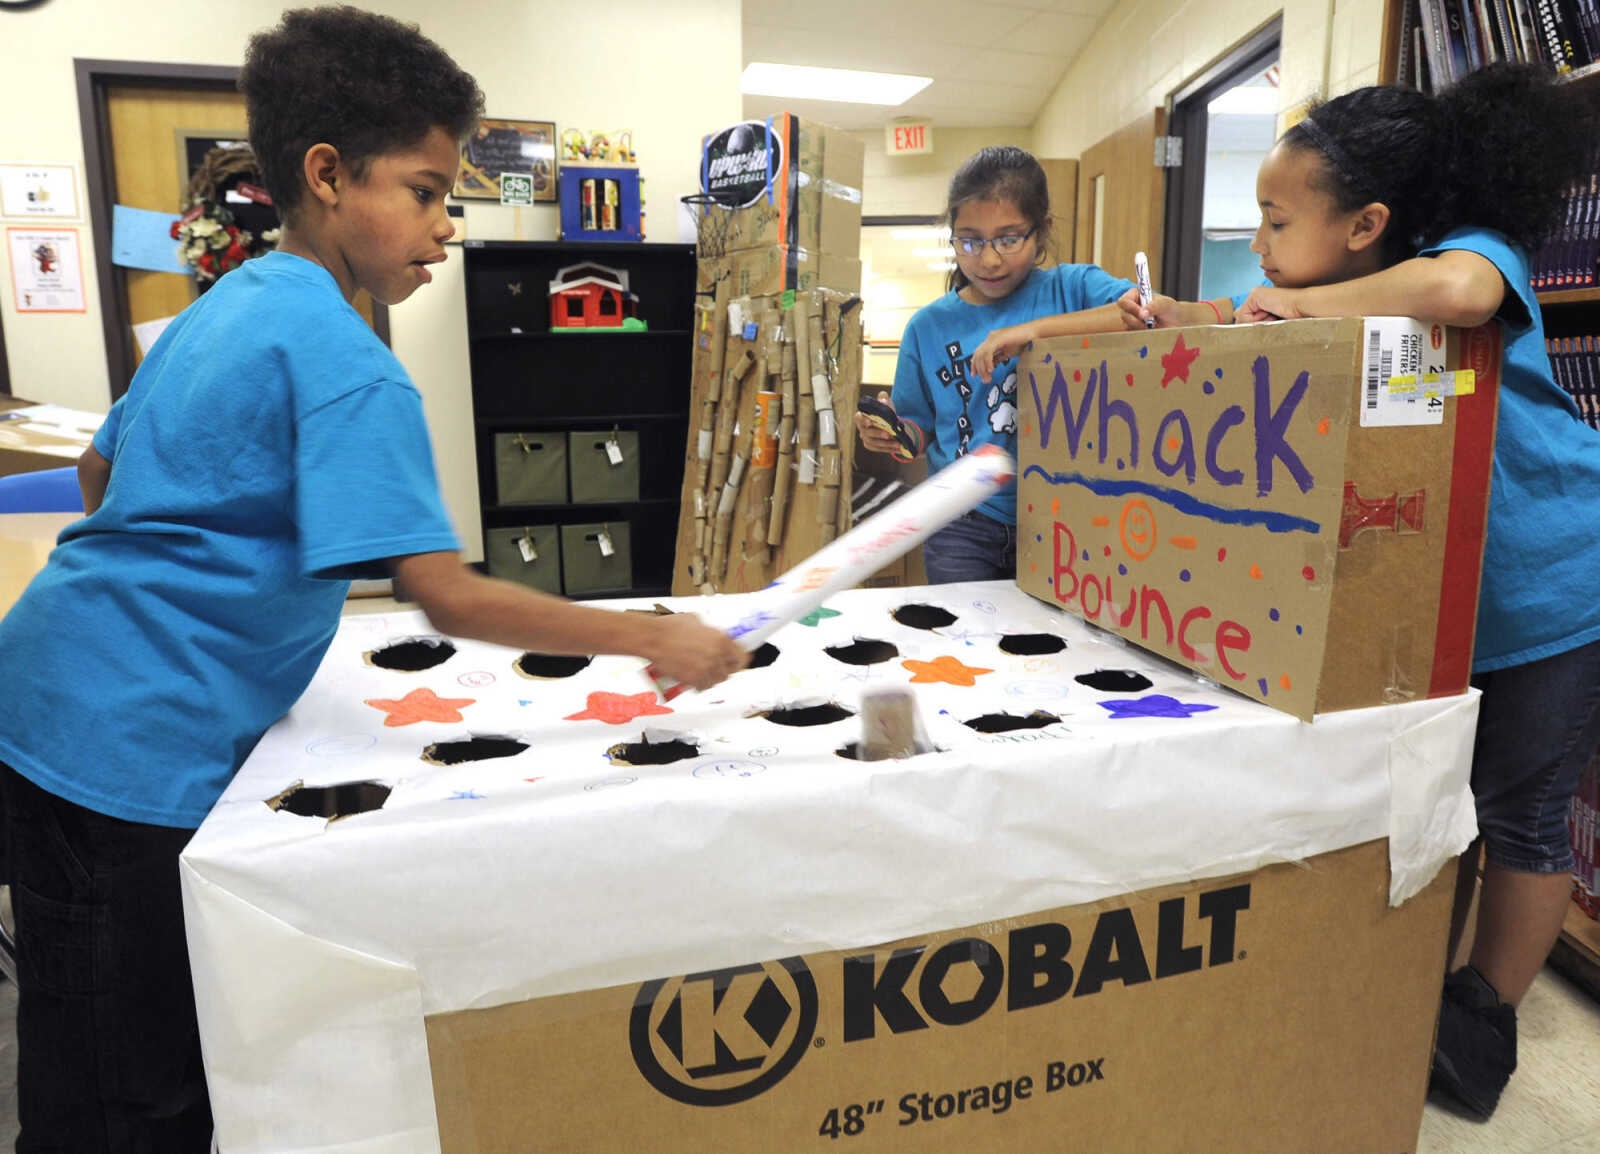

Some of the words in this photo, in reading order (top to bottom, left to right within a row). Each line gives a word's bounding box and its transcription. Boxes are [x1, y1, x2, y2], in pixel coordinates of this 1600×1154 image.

[895, 123, 925, 151] EXIT
[711, 171, 766, 189] BASKETBALL
[1400, 334, 1409, 374] FRITTERS
[1409, 334, 1418, 372] CHICKEN
[1052, 521, 1251, 681] Bounce
[842, 884, 1251, 1043] KOBALT
[898, 1074, 1034, 1127] Storage
[1045, 1056, 1105, 1093] Box
